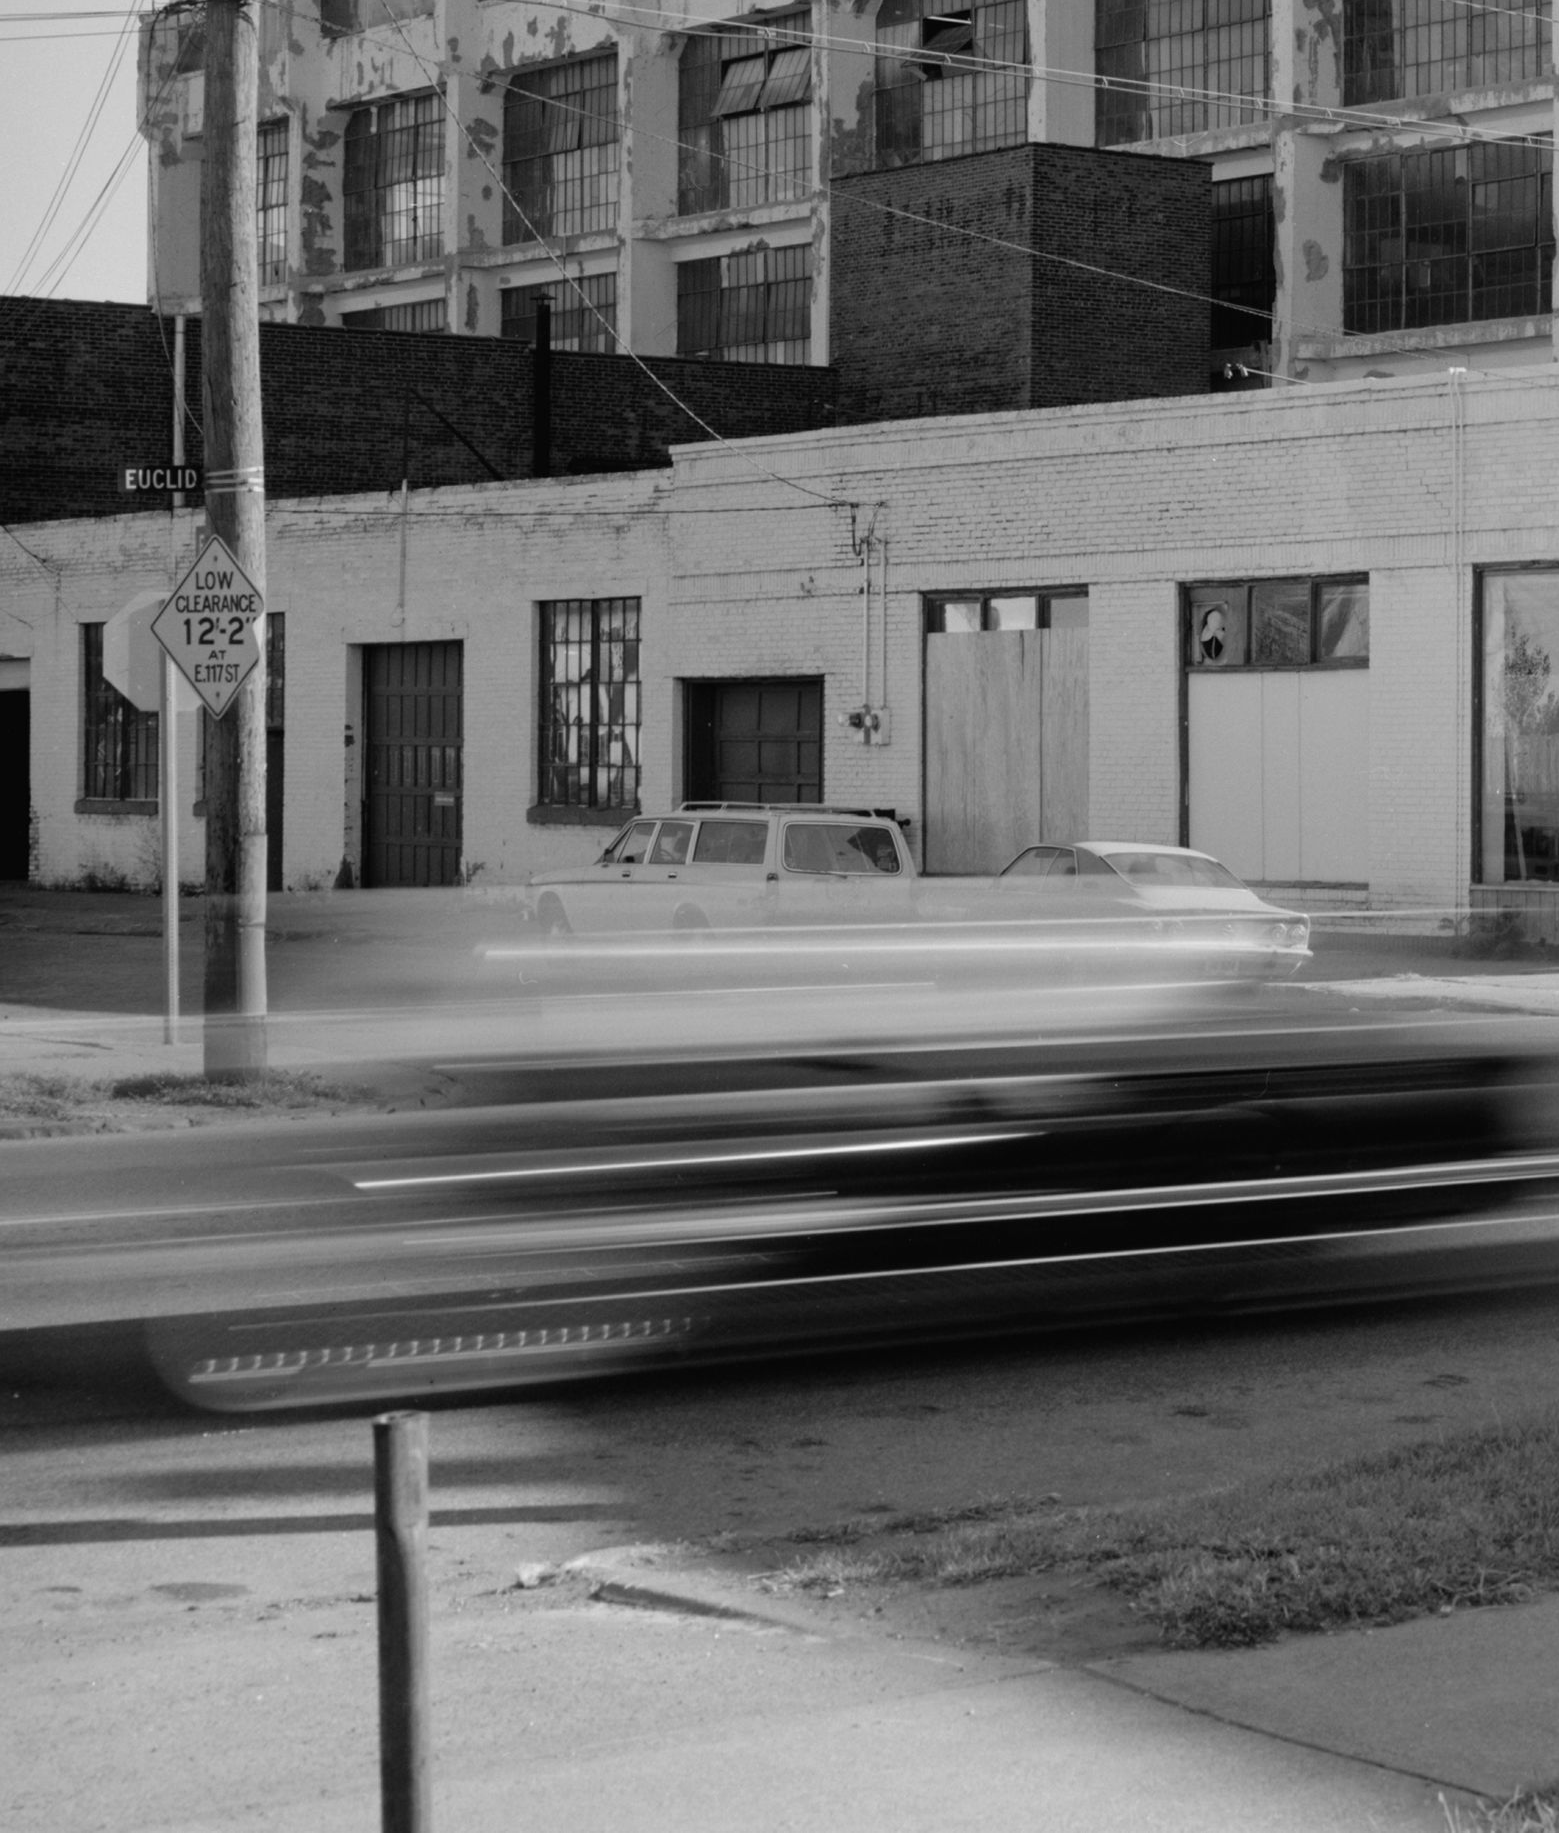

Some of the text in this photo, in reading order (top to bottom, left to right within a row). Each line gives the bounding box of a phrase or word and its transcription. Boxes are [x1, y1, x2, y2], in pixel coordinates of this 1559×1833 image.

[125, 469, 197, 489] EUCLID
[196, 571, 234, 590] LOW
[175, 594, 257, 613] CLEARANCE
[208, 650, 227, 660] AT
